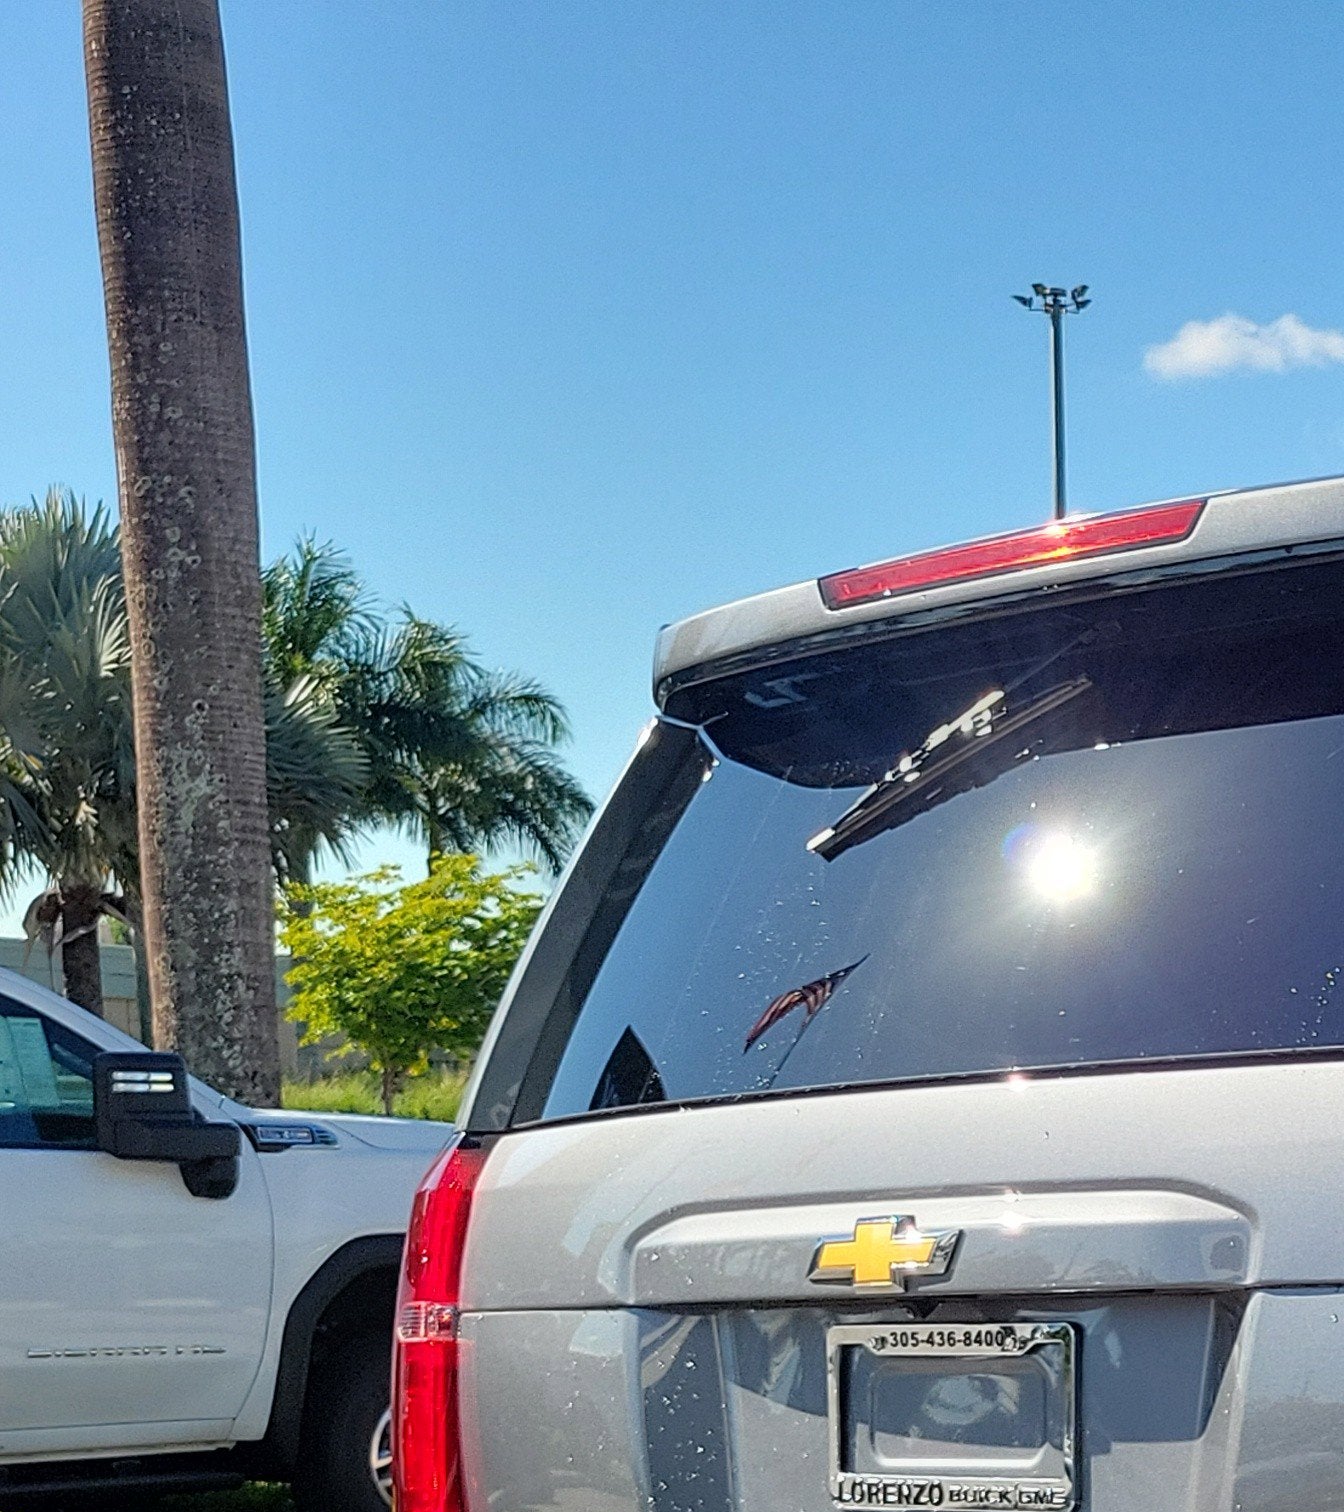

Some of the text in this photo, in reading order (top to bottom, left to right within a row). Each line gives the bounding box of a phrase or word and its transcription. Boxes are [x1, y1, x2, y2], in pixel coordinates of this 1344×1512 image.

[890, 1331, 1004, 1348] 305-436-8400
[836, 1479, 944, 1505] LORENZO
[950, 1486, 1013, 1505] BUICK
